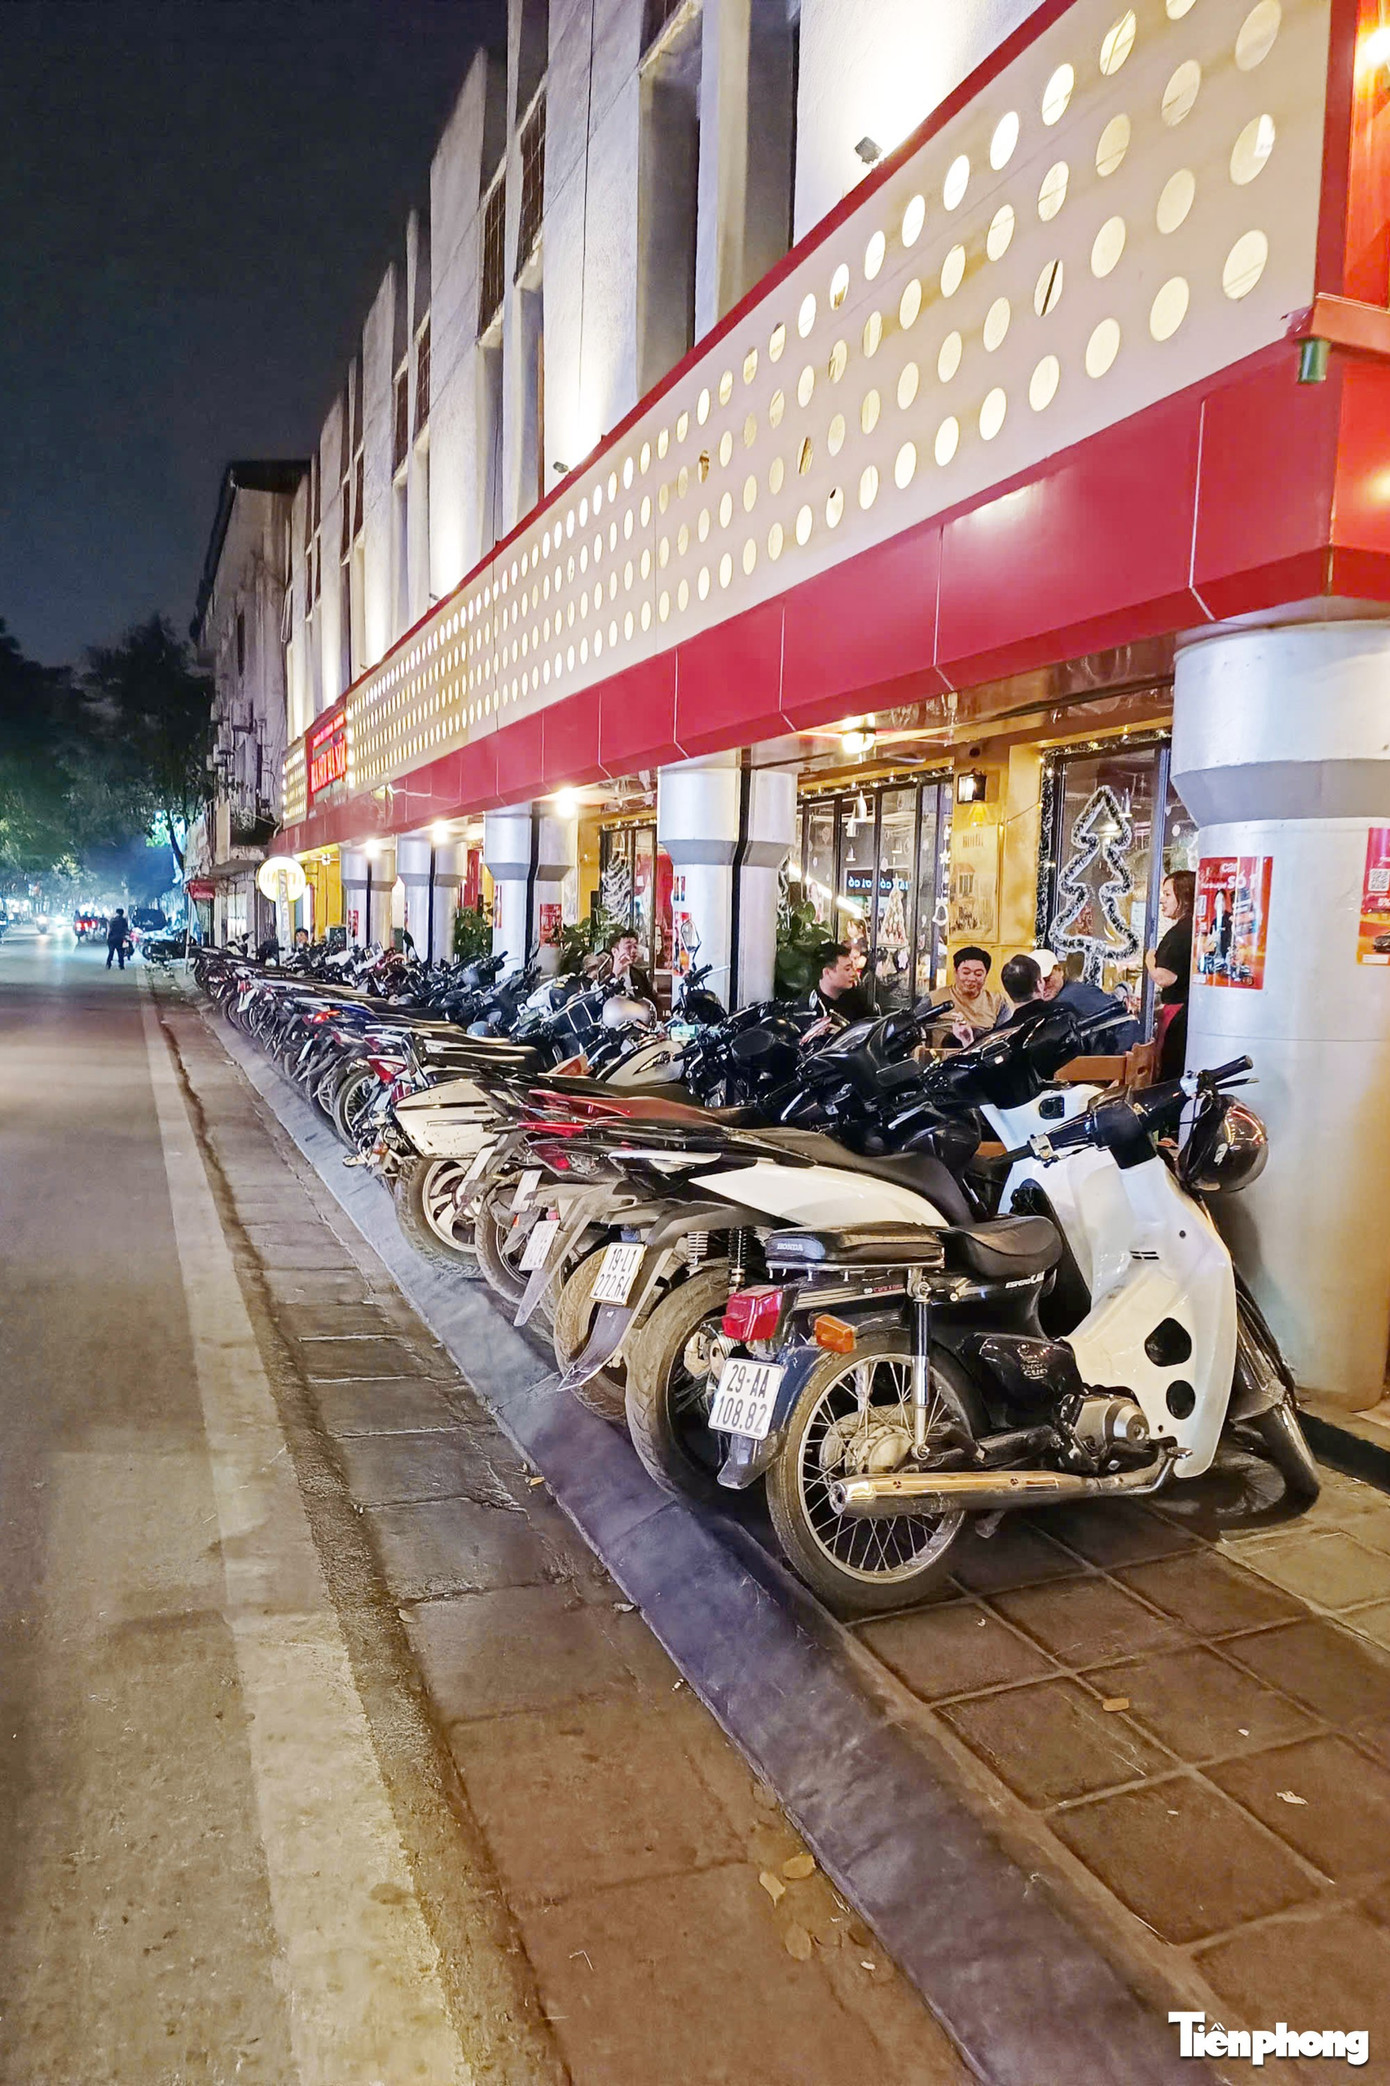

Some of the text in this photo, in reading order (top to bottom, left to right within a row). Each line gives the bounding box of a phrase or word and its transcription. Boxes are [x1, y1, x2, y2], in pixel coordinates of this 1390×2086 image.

[777, 1242, 803, 1251] HONDA
[726, 1363, 770, 1398] 29-AA
[716, 1395, 768, 1434] 108.82
